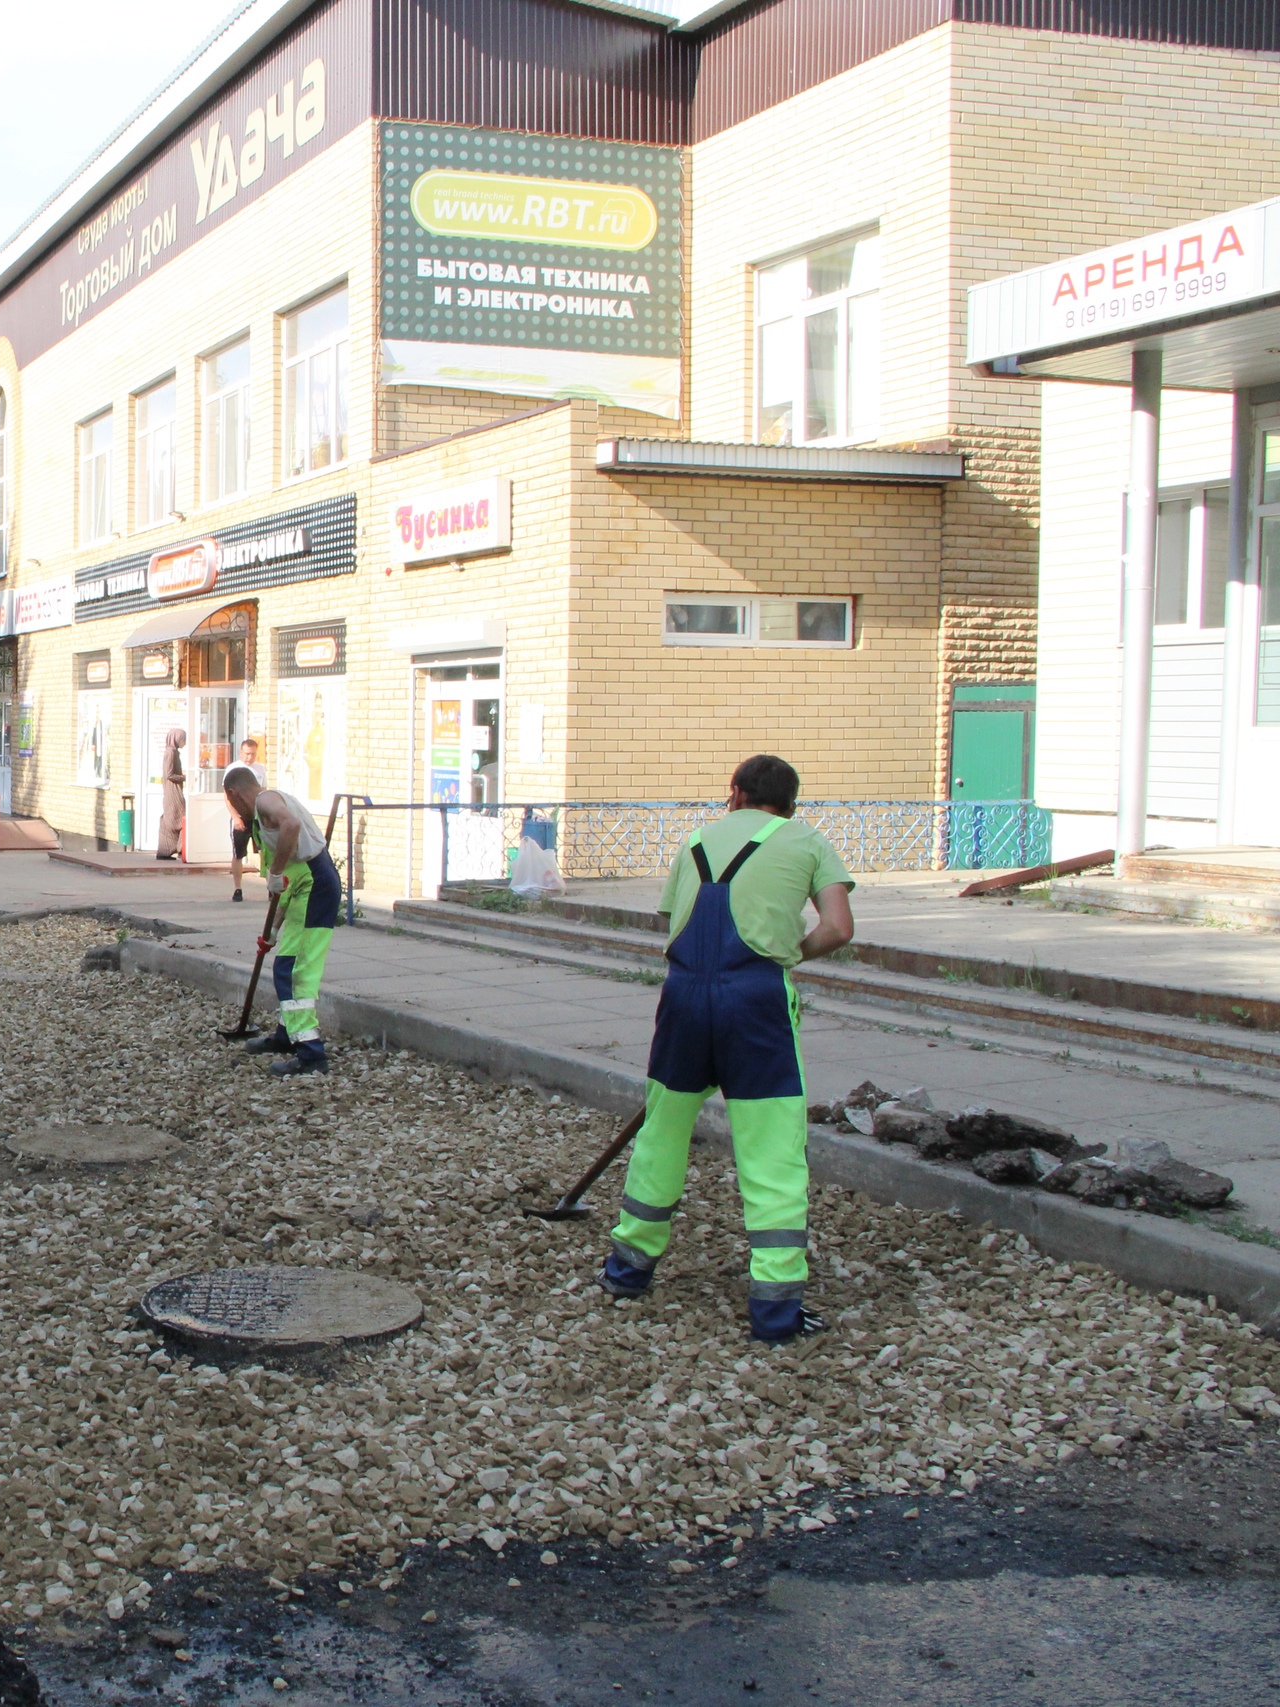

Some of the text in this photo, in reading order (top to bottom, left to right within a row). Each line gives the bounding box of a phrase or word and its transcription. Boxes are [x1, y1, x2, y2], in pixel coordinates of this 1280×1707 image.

[190, 57, 326, 225] Удача
[433, 188, 515, 203] real brand technics
[433, 194, 630, 235] www.RBT.ru
[59, 224, 136, 327] Торговый
[417, 258, 651, 295] БЫТОВАЯ ТЕХНИКА
[1052, 225, 1245, 307] АРЕНДА
[434, 286, 635, 319] И ЭЛЕКТРОНИКА
[1065, 271, 1228, 329] 8 (919) 697 9999
[395, 498, 490, 552] Бусинка
[214, 529, 305, 572] ЭЛЕКТРОНИКА
